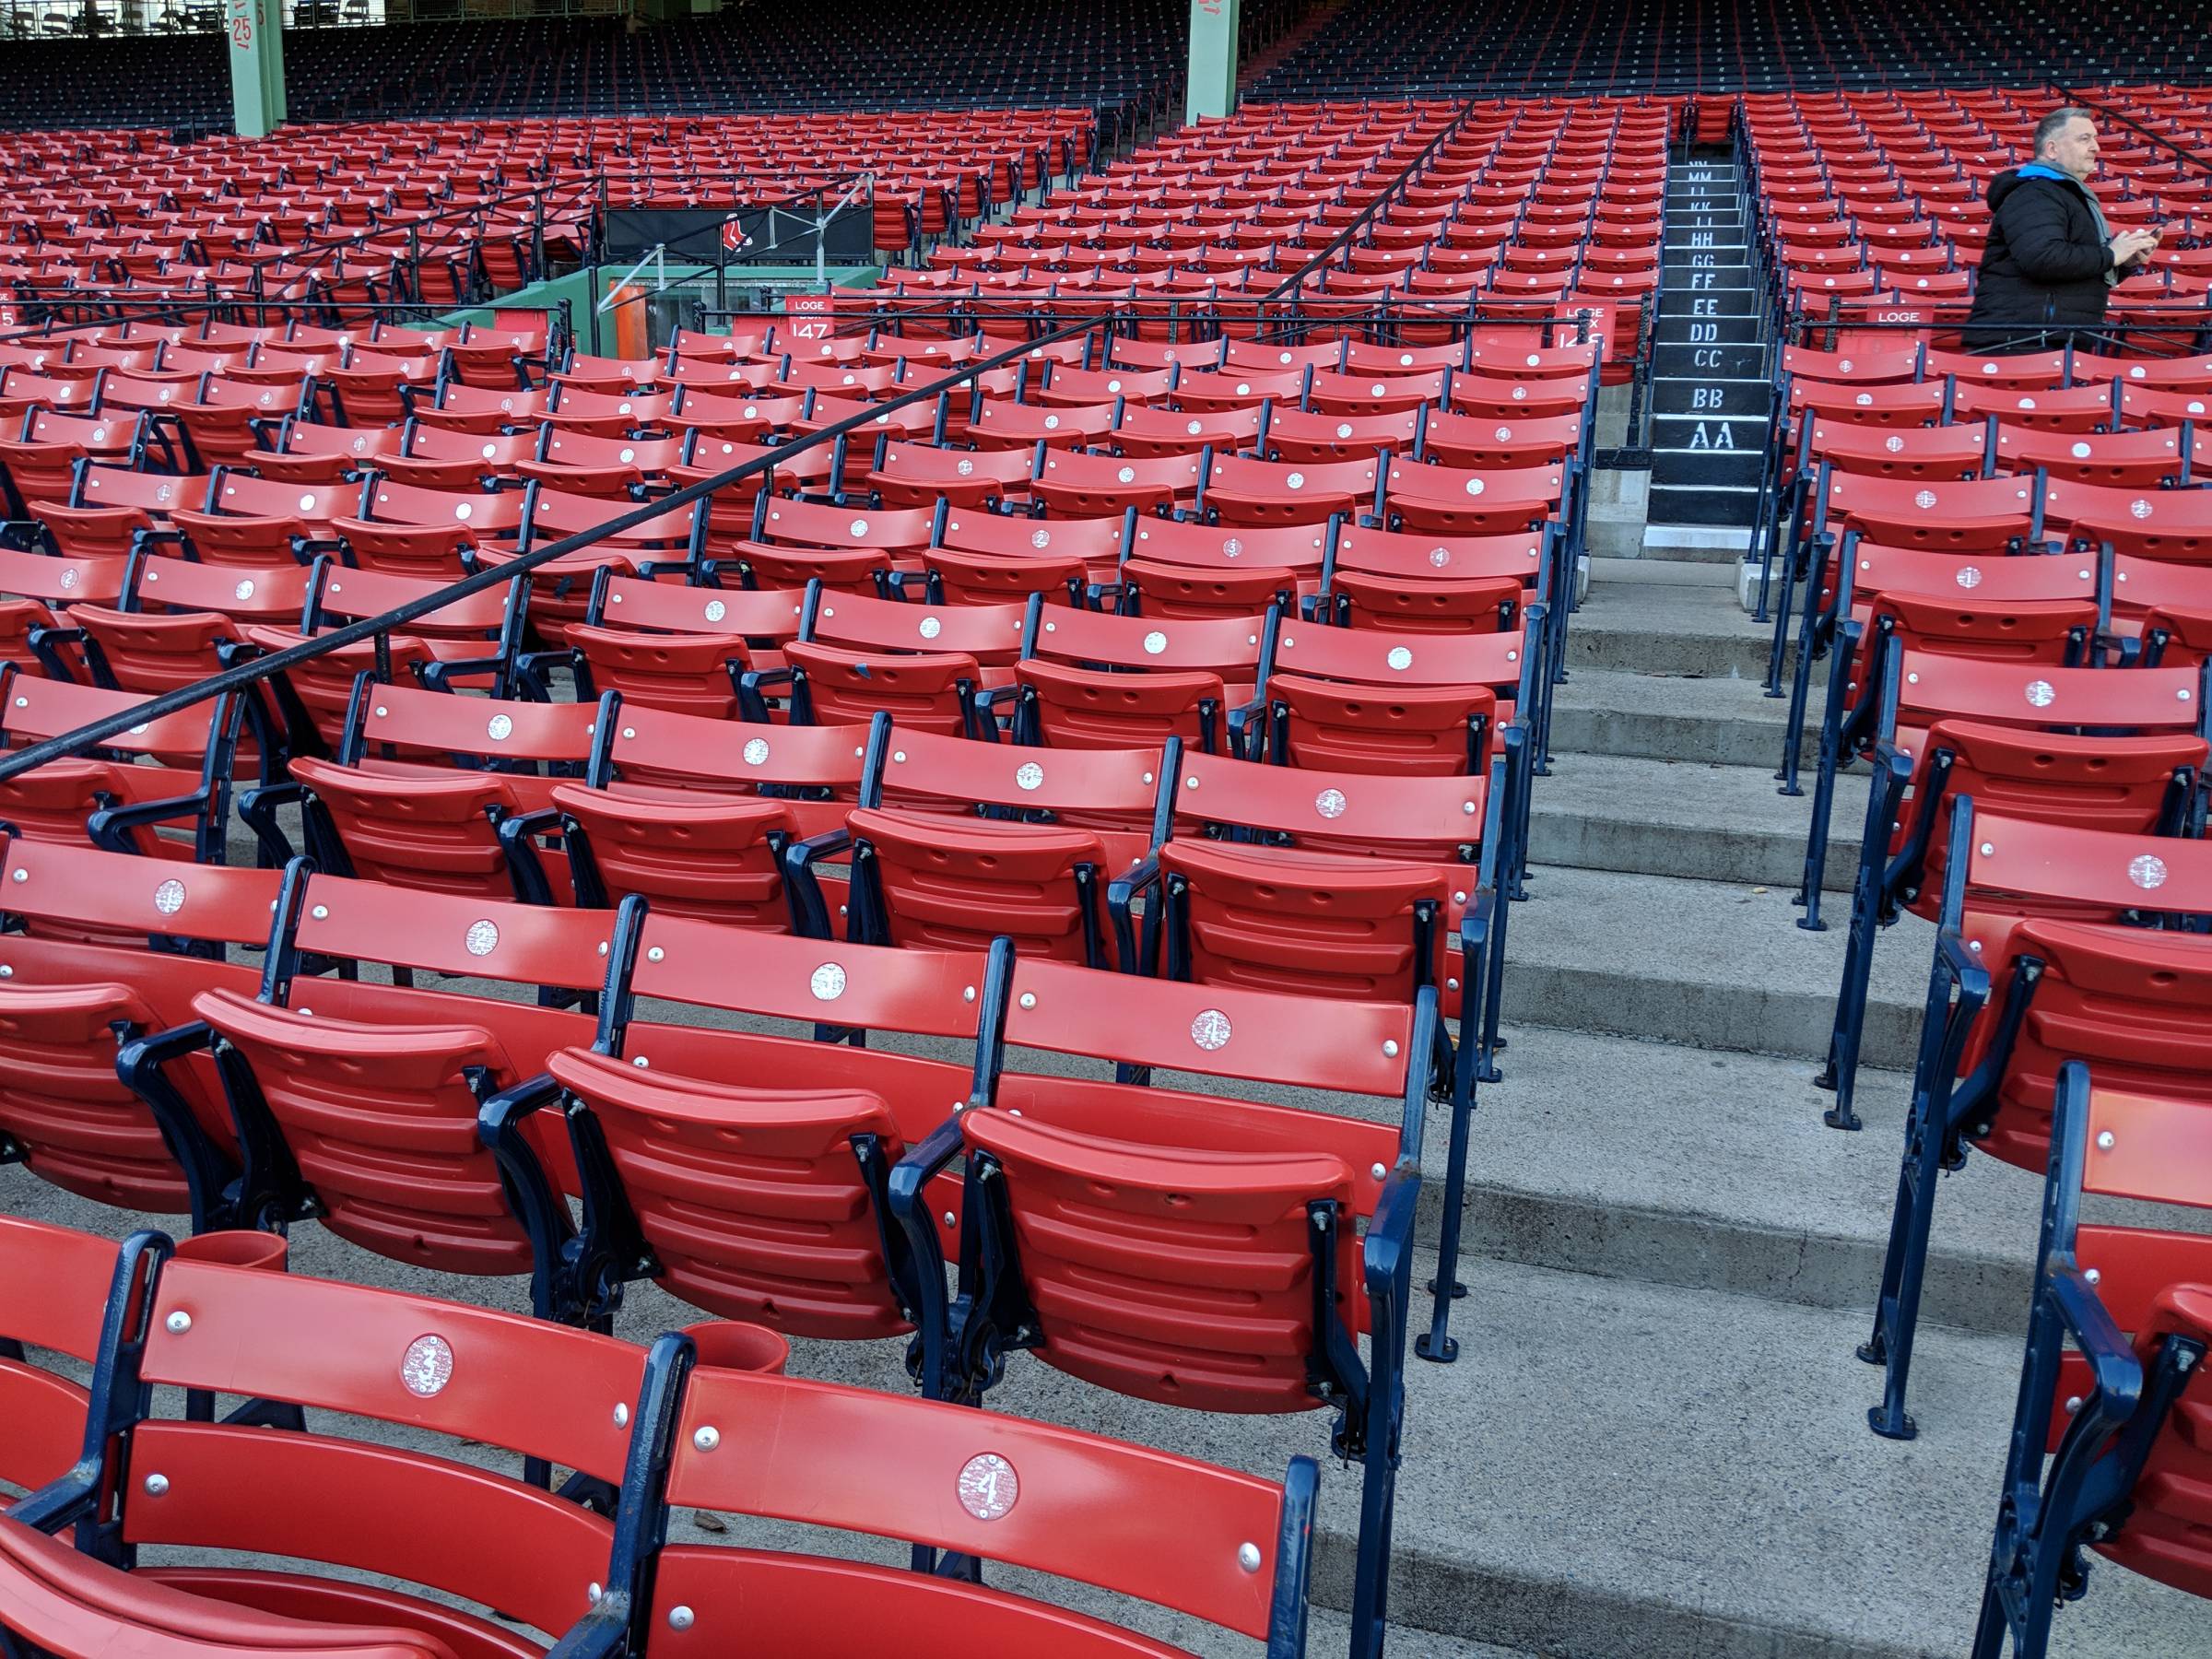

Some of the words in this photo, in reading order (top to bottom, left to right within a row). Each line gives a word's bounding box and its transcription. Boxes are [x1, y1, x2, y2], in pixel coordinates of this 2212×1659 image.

[233, 18, 252, 41] 25
[1691, 232, 1712, 246] HH
[1692, 253, 1715, 265] GG
[1691, 273, 1715, 288] FF
[795, 300, 826, 311] LOGE
[1693, 299, 1718, 314] EE
[1878, 312, 1921, 323] LOGE
[793, 323, 828, 339] 147
[1689, 324, 1717, 341] DD
[1694, 349, 1723, 367] CC
[1692, 388, 1724, 408] BB
[1689, 421, 1734, 449] AA
